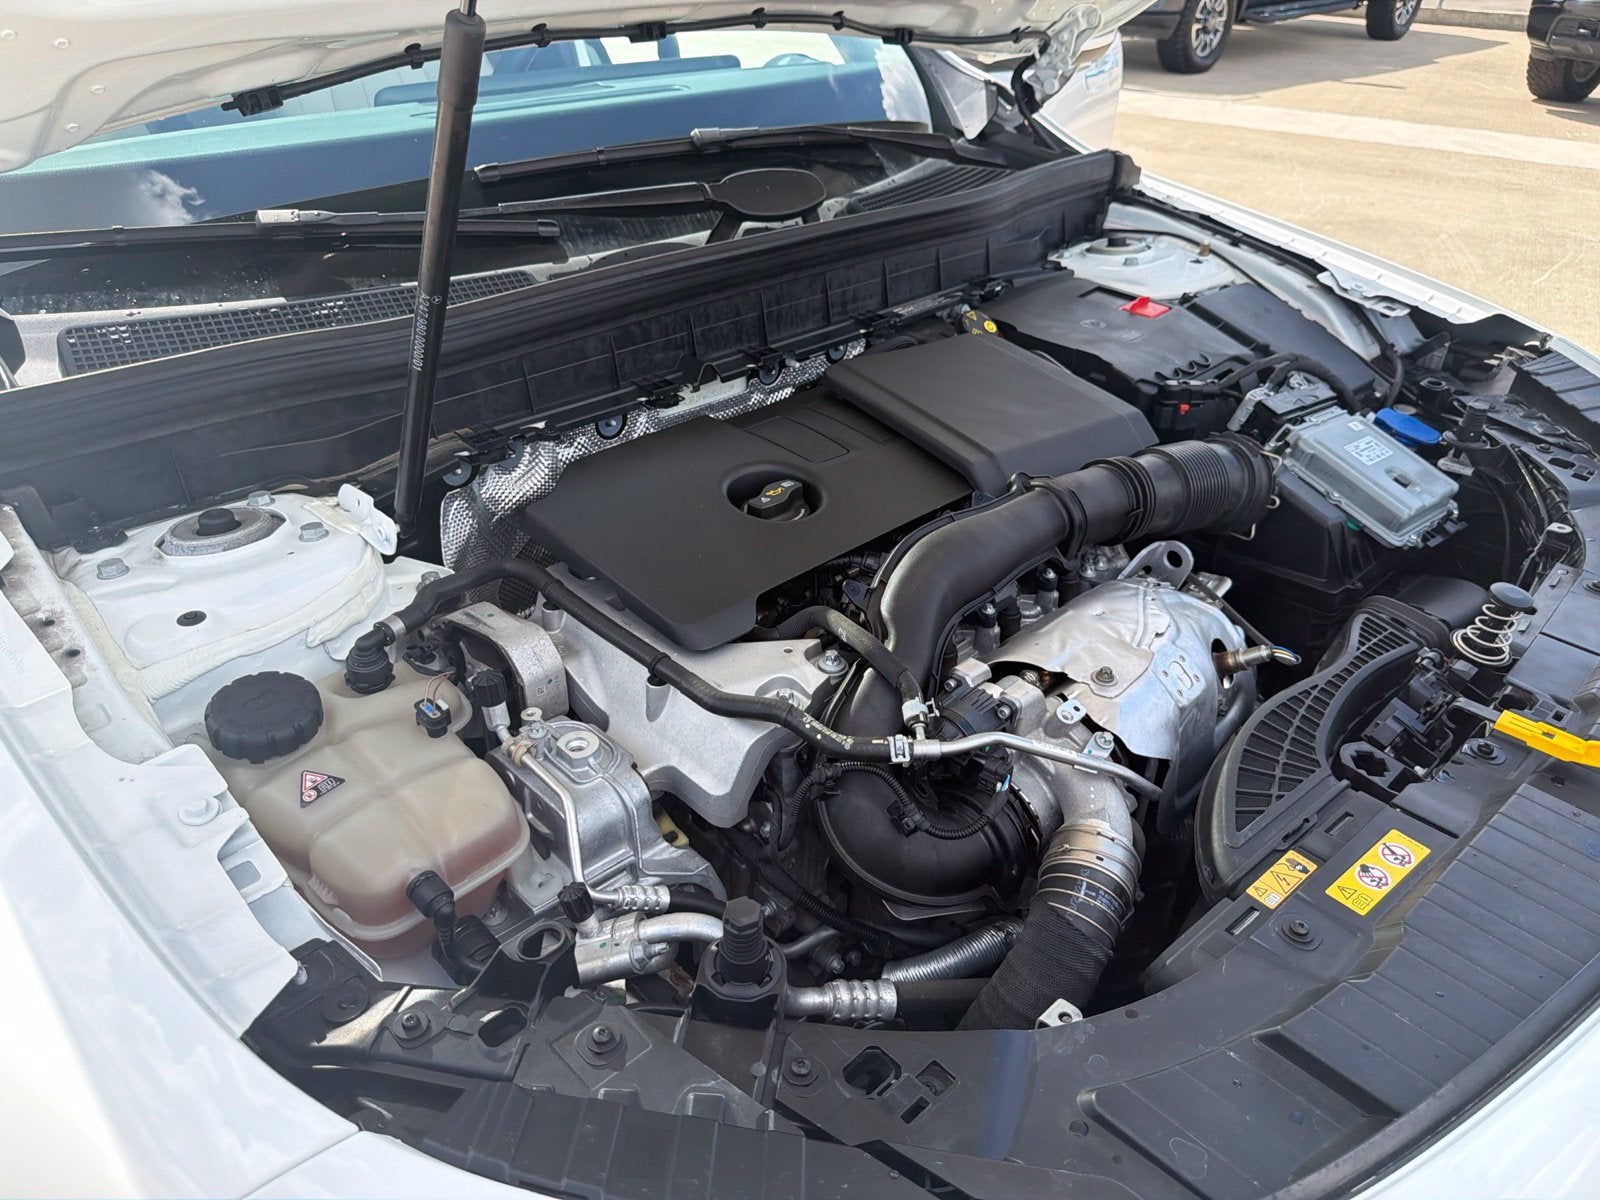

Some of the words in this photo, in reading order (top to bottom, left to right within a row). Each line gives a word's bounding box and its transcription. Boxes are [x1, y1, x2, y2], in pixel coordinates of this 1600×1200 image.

[419, 290, 430, 317] A247
[415, 317, 428, 336] 980
[412, 335, 426, 371] 0000/01
